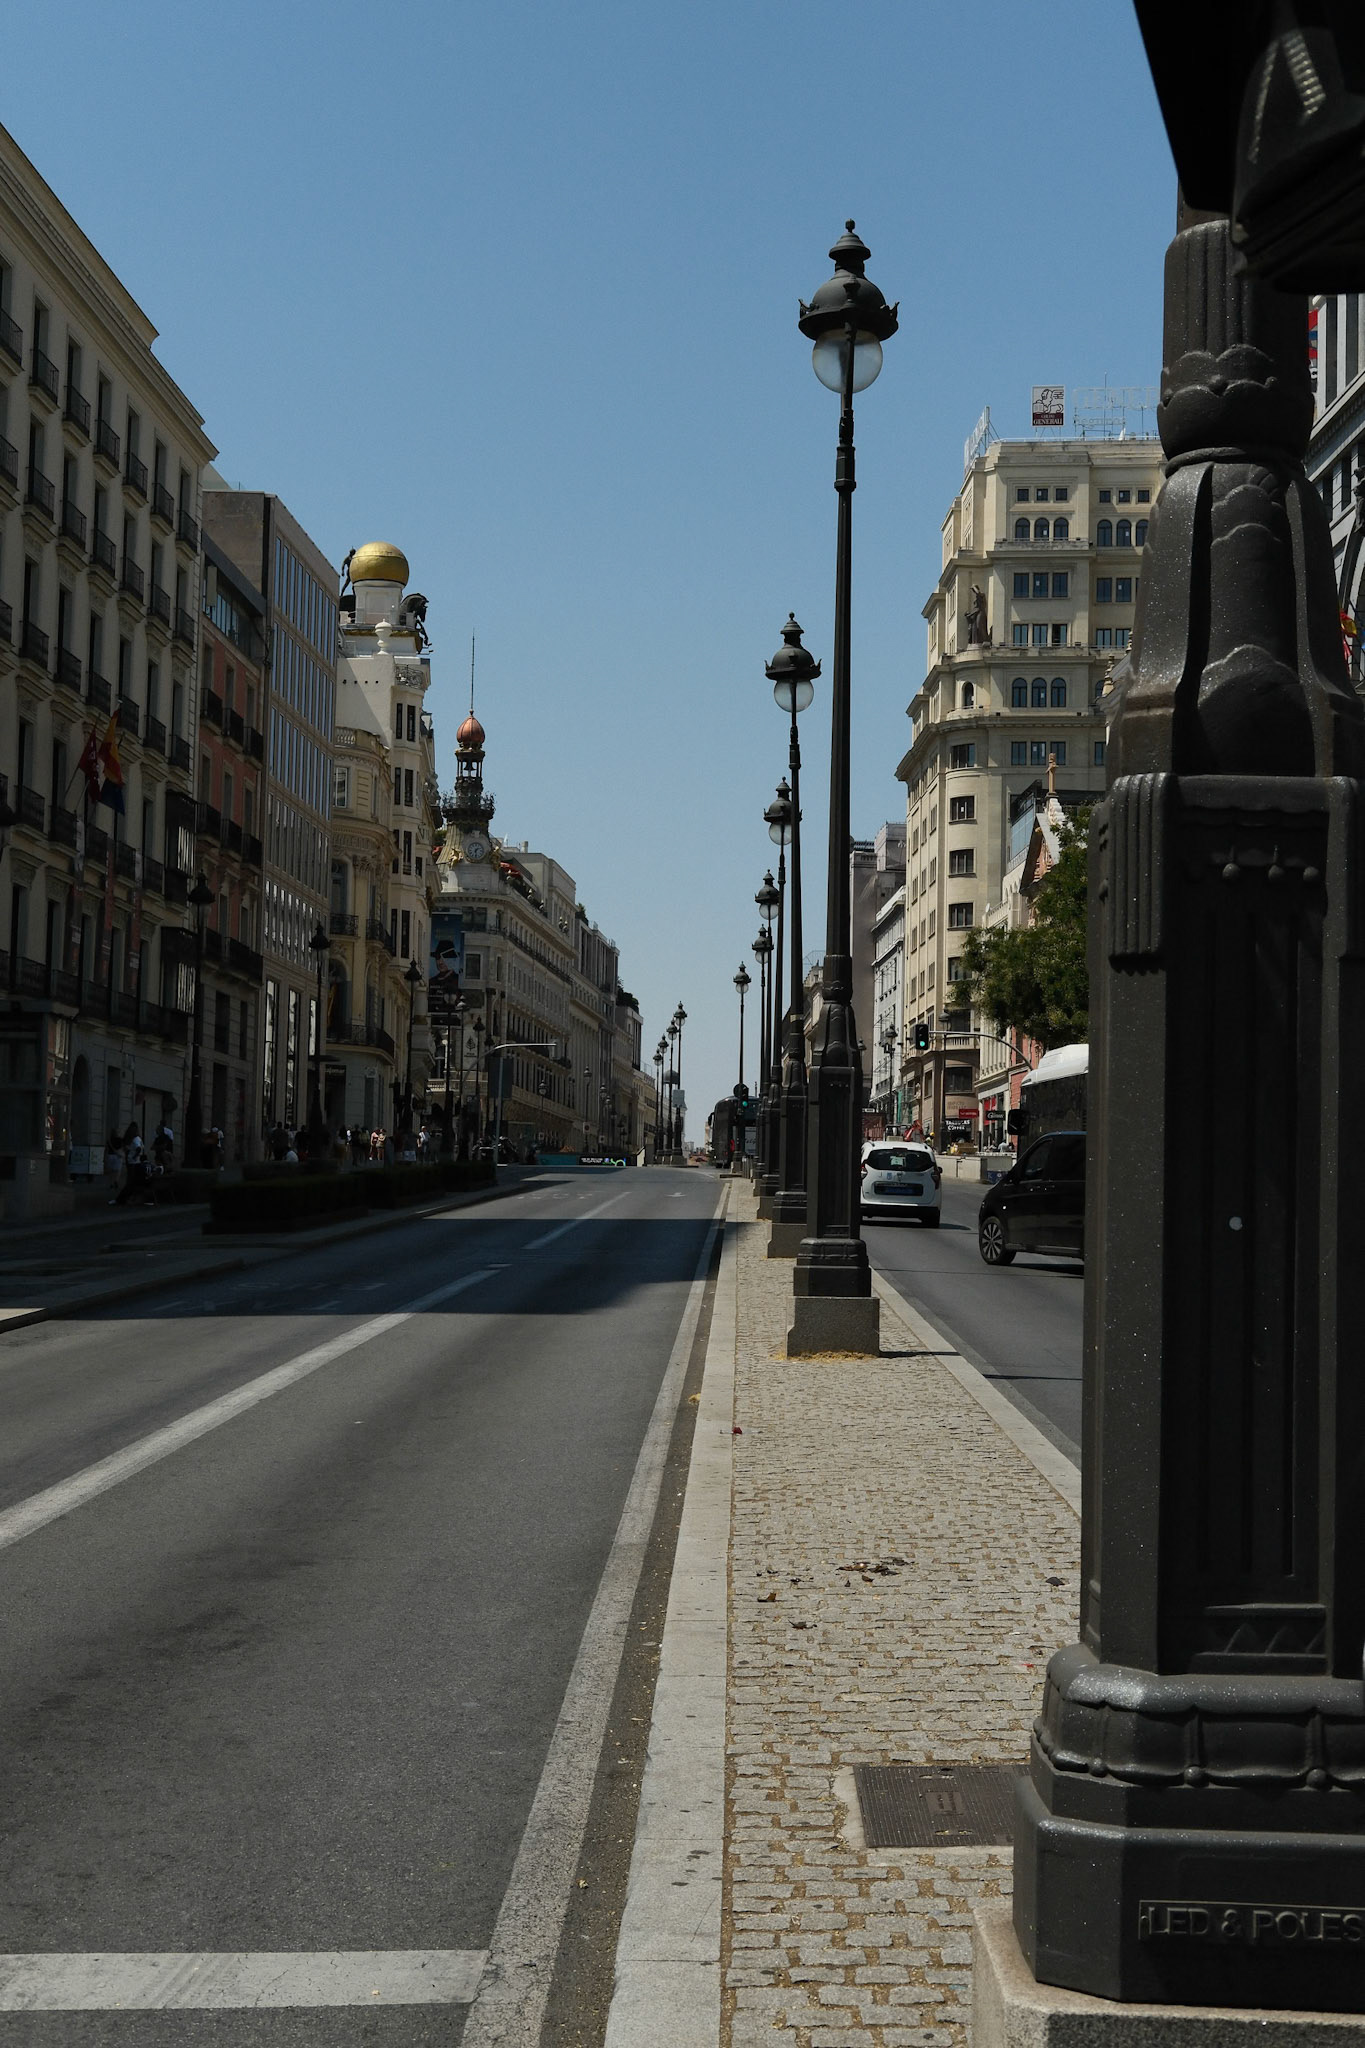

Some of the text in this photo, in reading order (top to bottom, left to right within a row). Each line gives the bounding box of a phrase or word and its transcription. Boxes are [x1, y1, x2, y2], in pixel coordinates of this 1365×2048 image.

[1149, 1906, 1363, 1942] LED & POLES
